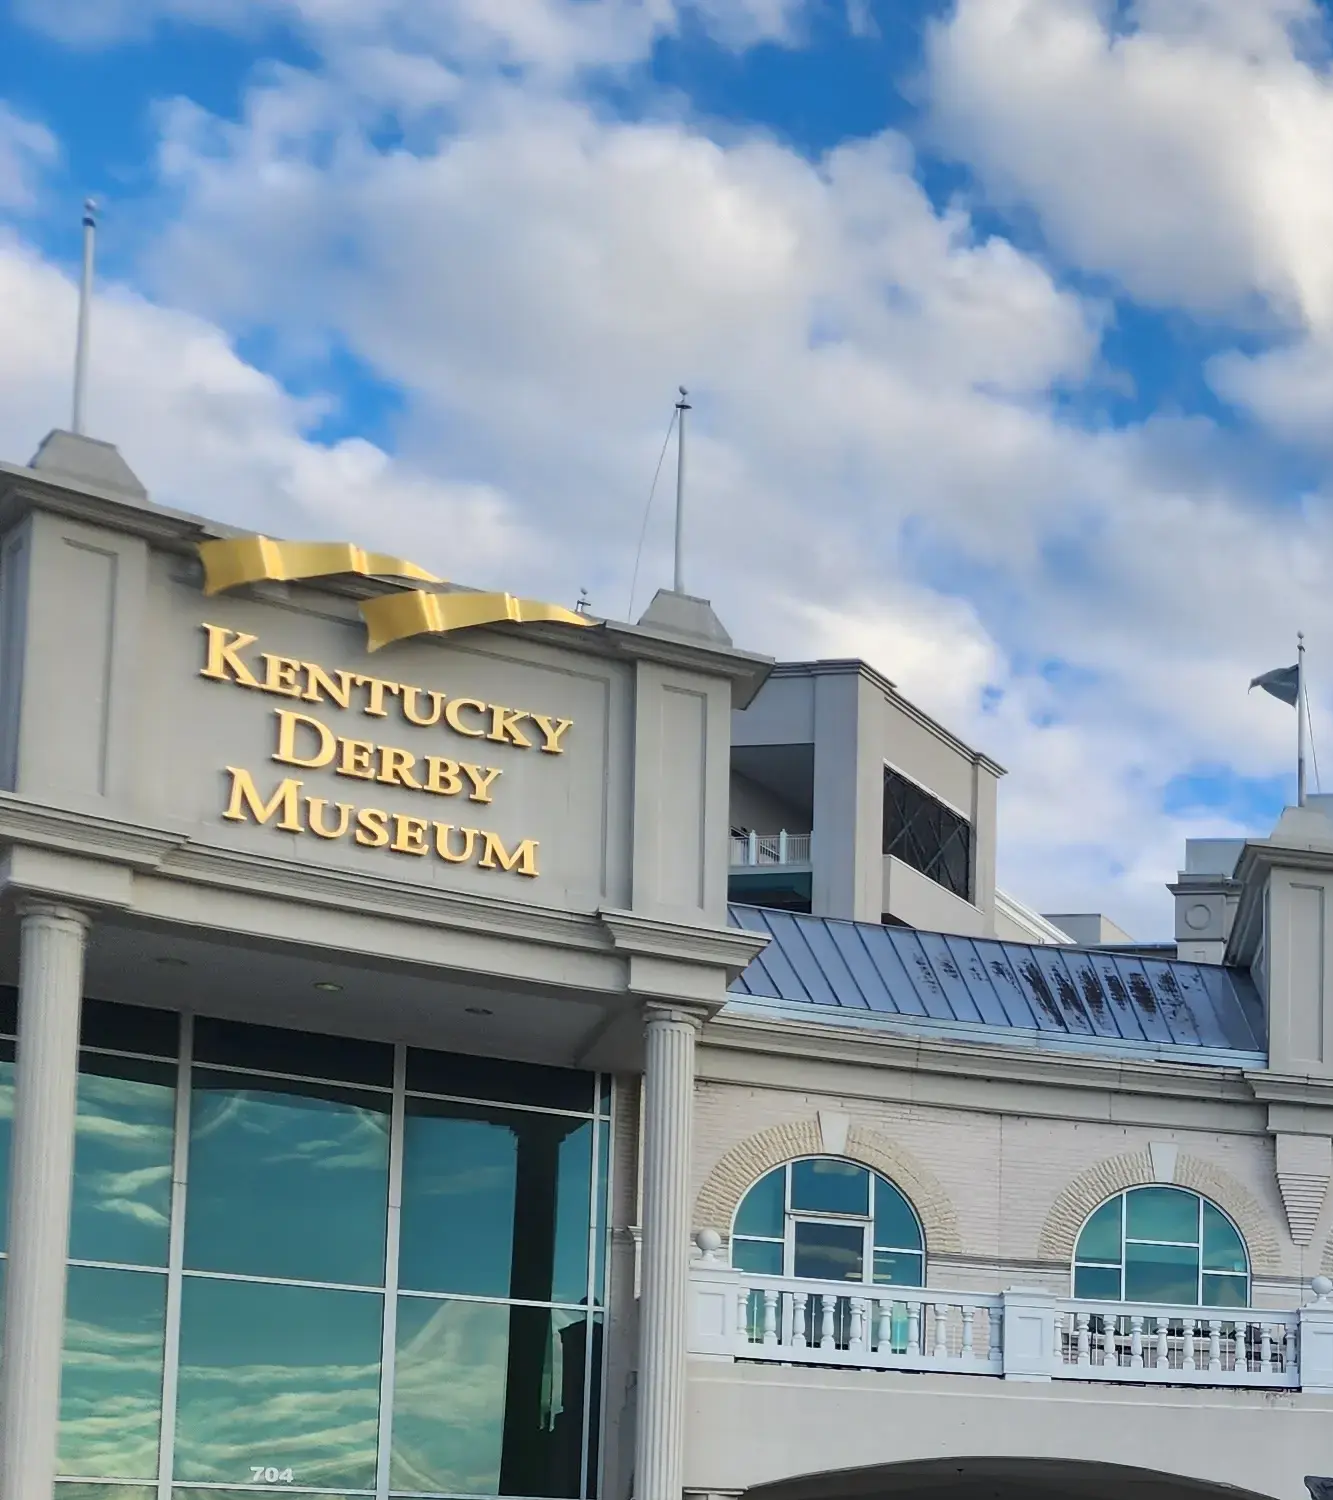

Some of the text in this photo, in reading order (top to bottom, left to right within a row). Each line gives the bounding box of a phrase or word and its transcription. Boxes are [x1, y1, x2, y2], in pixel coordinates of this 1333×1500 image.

[199, 622, 573, 755] KENTUCKY
[271, 707, 503, 804] DERBY
[222, 766, 540, 878] MUSEUM
[249, 1466, 294, 1483] 704
